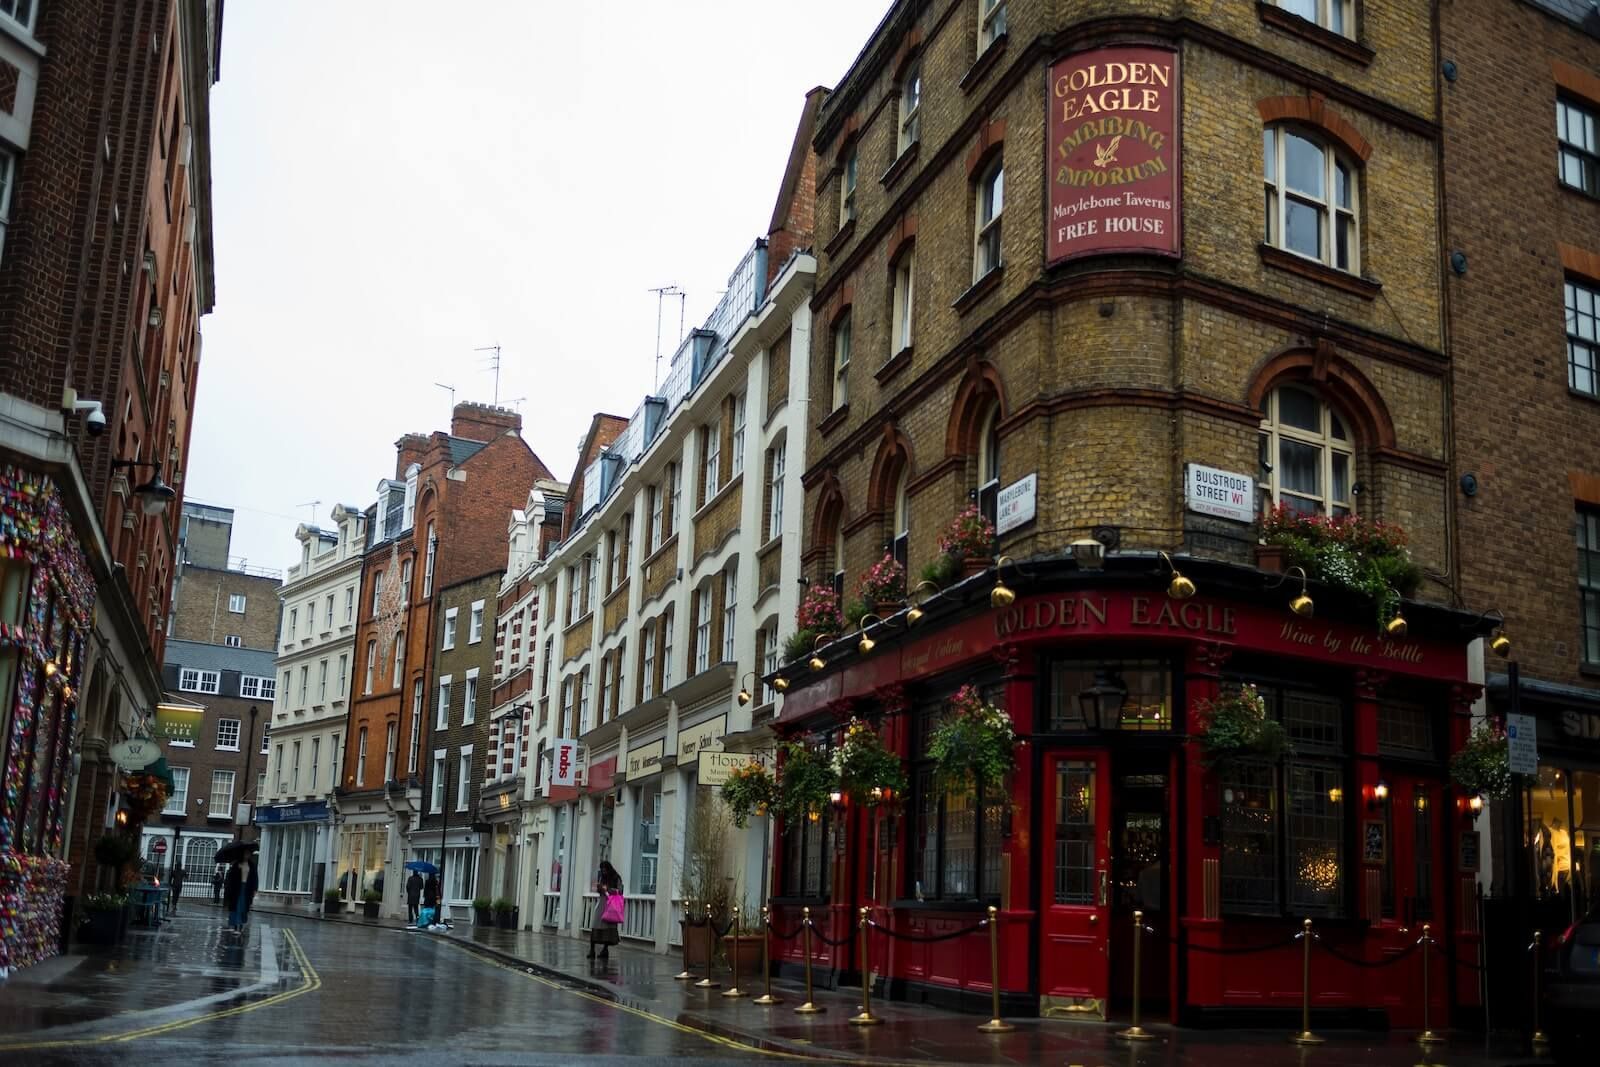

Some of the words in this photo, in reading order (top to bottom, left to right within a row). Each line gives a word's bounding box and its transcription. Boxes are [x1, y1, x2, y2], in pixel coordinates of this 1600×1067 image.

[1055, 62, 1170, 98] GOLDEN
[1063, 88, 1161, 122] EAGLE
[1058, 115, 1167, 159] IMBIBING
[1056, 156, 1168, 188] EMPORIUM
[1053, 195, 1121, 221] Marylebone
[1123, 191, 1171, 210] Taverns
[1058, 220, 1098, 243] FREE
[1105, 217, 1164, 235] HOUSE
[1000, 480, 1031, 506] MARYLEBONE
[1196, 470, 1247, 492] BULSTRODE
[1196, 484, 1229, 502] STREET
[1232, 492, 1243, 505] W1
[994, 598, 1108, 638] GOLDEN
[1131, 597, 1238, 634] EAGLE
[1280, 621, 1316, 645] Wine
[1323, 629, 1342, 653] by
[1350, 635, 1373, 654] the
[1379, 640, 1424, 664] Bottle
[559, 746, 572, 778] hobs
[710, 754, 745, 769] Hope
